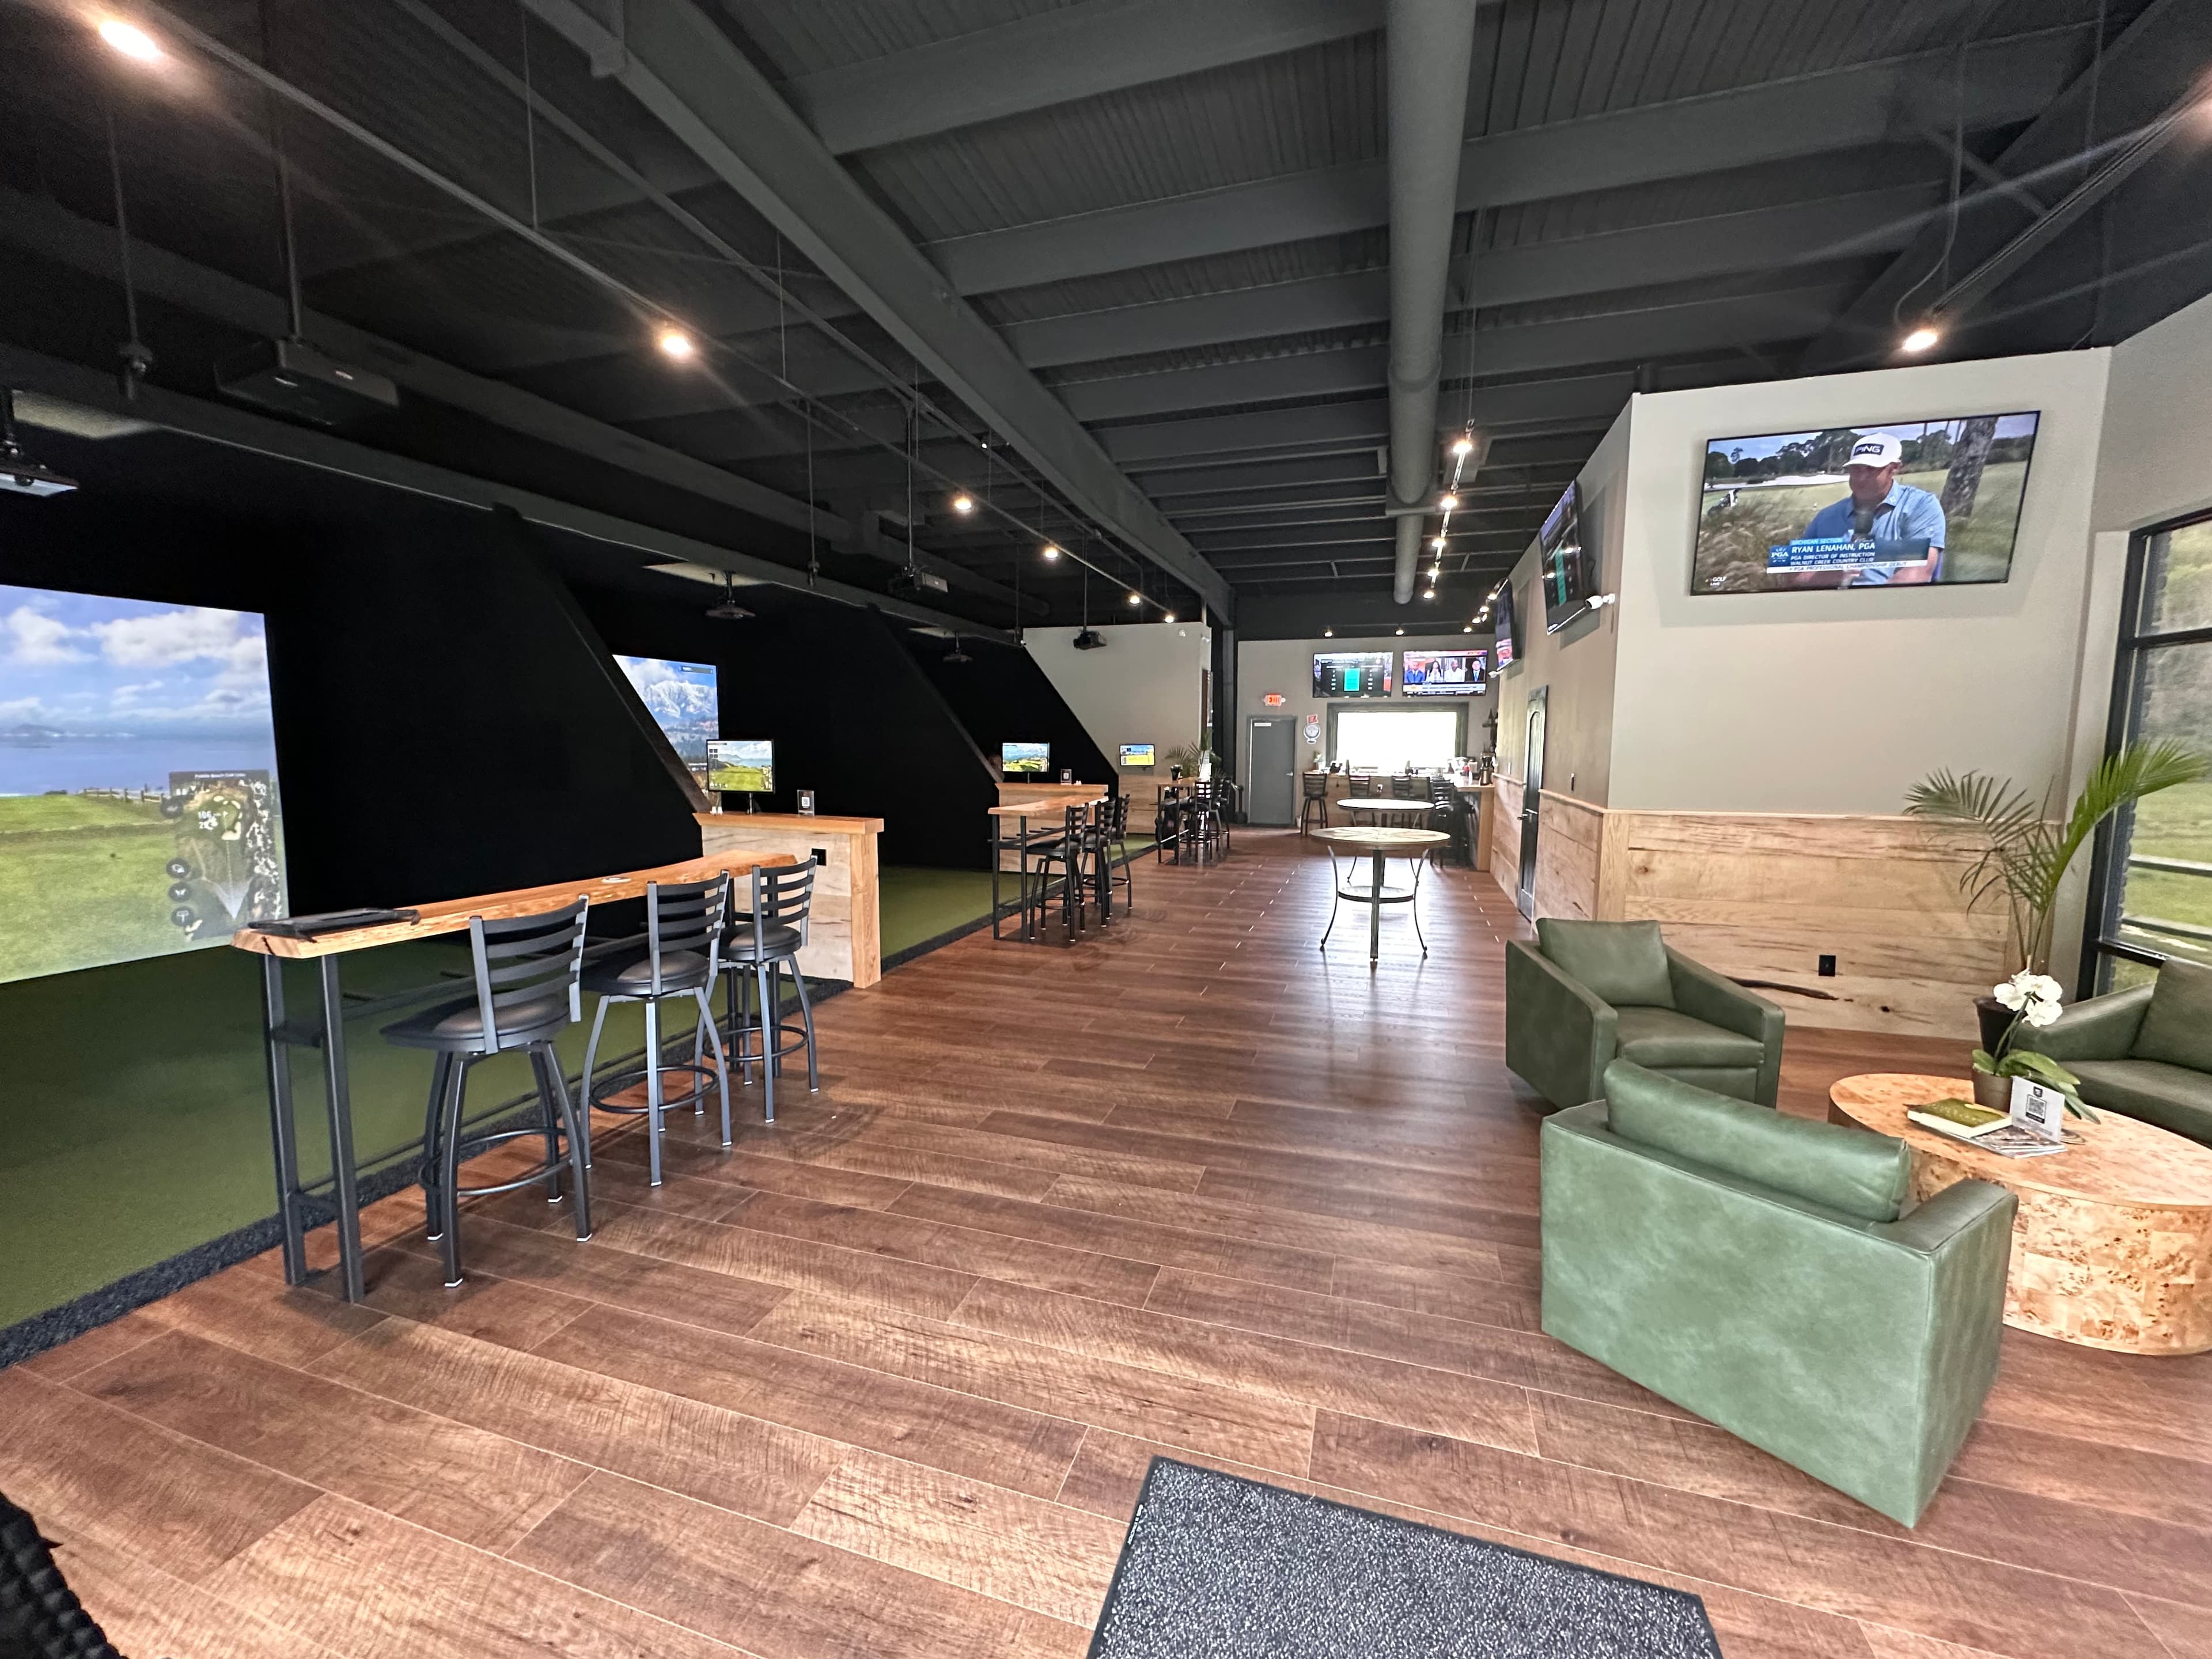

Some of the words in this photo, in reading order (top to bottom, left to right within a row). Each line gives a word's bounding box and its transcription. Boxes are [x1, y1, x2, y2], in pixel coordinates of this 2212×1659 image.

[1855, 445, 1881, 453] PING
[1791, 546, 1814, 554] RYAN
[1816, 543, 1855, 552] LENAHAN,
[1858, 542, 1876, 550] PGA
